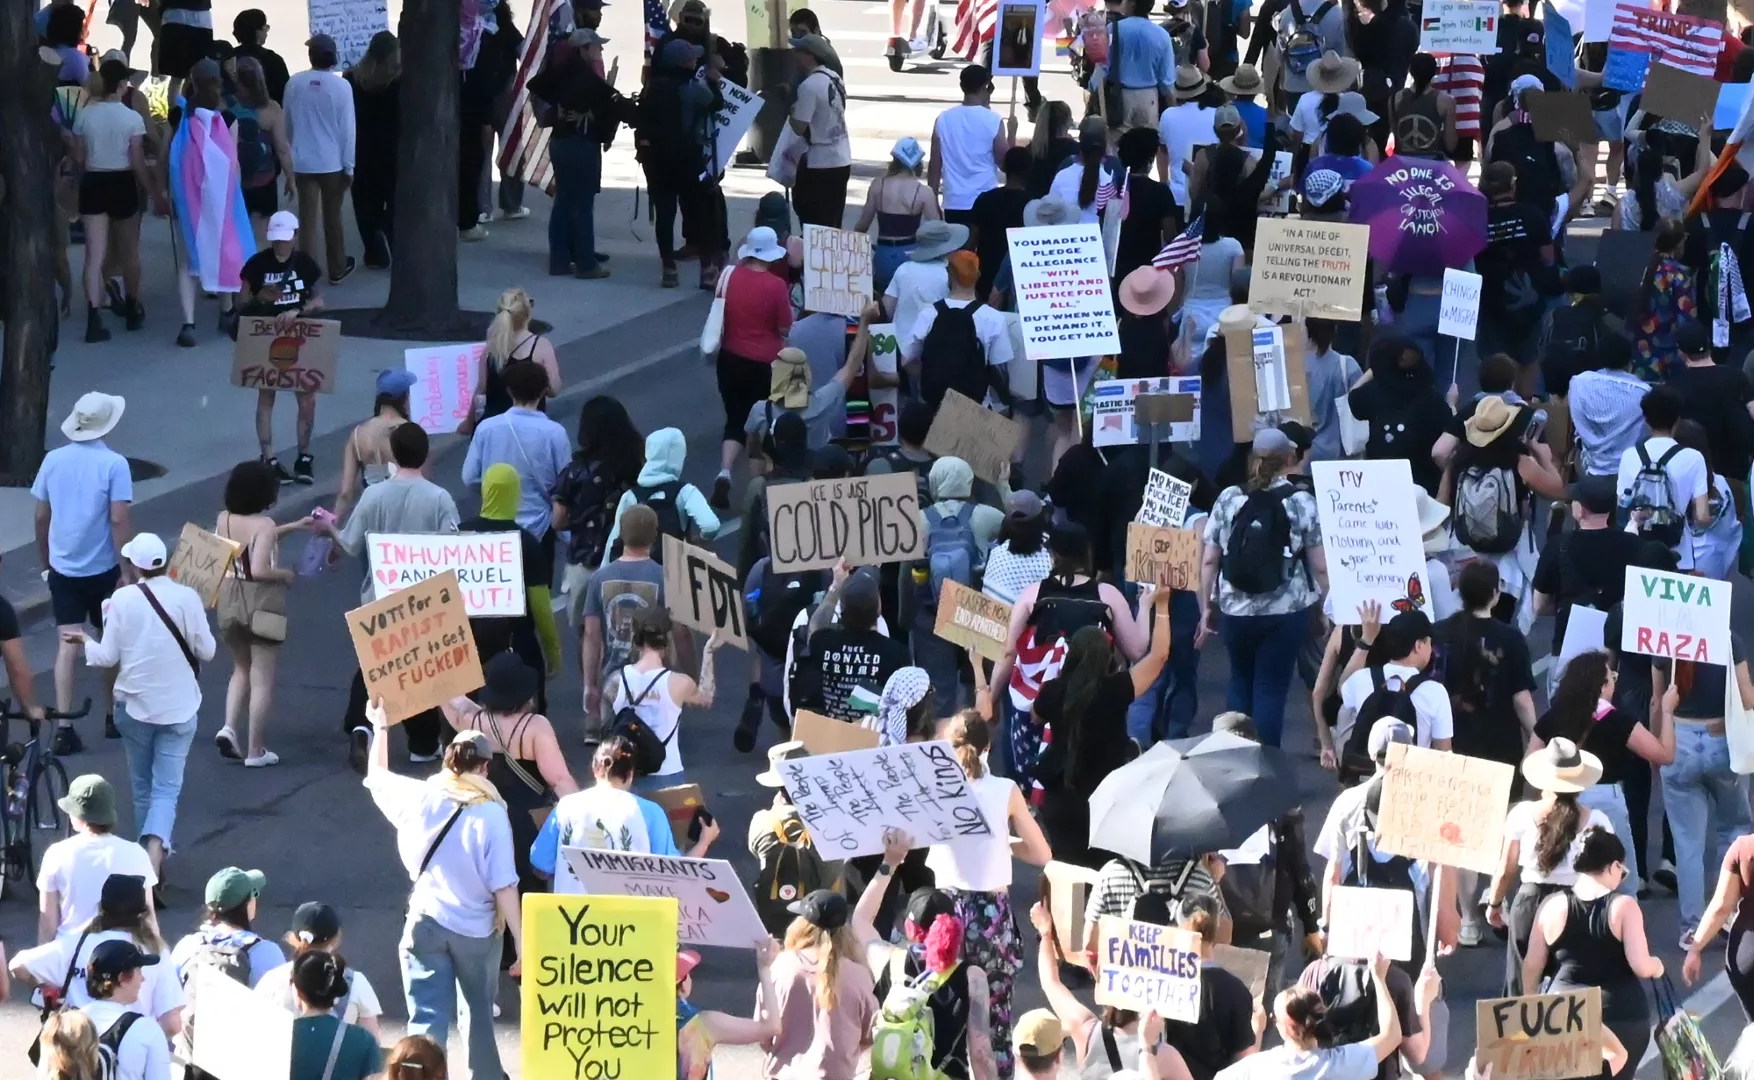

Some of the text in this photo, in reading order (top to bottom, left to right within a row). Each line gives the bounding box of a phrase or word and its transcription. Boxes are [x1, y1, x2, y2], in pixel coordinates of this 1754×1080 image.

[728, 88, 752, 105] NOW
[1384, 167, 1455, 191] NO ONE IS
[1399, 184, 1443, 206] ILLEGAL
[1014, 235, 1098, 251] YOU MADE US
[1296, 229, 1303, 237] A
[1306, 230, 1327, 240] TIME
[1328, 231, 1341, 241] OF
[1032, 248, 1082, 257] PLEDGE
[1268, 242, 1351, 258] UNIVERSAL DECEIT,
[1020, 256, 1098, 268] ALLEGIANCE
[1265, 255, 1351, 271] TELLING THE TRUTH
[1021, 278, 1104, 290] LIBERTY AND
[1261, 271, 1352, 287] IS A REVOLUTIONARY
[1443, 279, 1479, 301] CHINGA
[1024, 287, 1104, 301] JUSTICE FOR
[1023, 310, 1112, 323] BUT WHEN WE
[1029, 330, 1114, 344] YOU GET MAD
[1034, 323, 1089, 333] DEMAND
[810, 480, 868, 501] ICE IS JUST
[1150, 471, 1190, 497] NO KINGS
[1145, 498, 1158, 512] NO
[774, 494, 919, 564] COLD PIGS
[376, 541, 513, 567] INHUMANE
[458, 567, 512, 584] RUEL
[686, 553, 742, 638] FDT
[1640, 574, 1712, 607] VIVA
[370, 611, 448, 661] RAPIST
[1636, 626, 1709, 662] RAZA
[367, 650, 421, 684] EXPECT
[398, 644, 471, 690] FUCKED!
[824, 650, 881, 665] DONALD
[822, 661, 880, 677] TRUMP
[952, 805, 991, 836] NO
[582, 851, 717, 882] IMMIGRANTS
[557, 904, 637, 947] Your
[1128, 924, 1163, 943] KEEP
[536, 956, 655, 987] Silence
[1102, 970, 1199, 1011] TOGETHER
[1492, 995, 1588, 1039] FUCK
[566, 1045, 622, 1080] You
[1487, 1037, 1592, 1075] TRUMP
